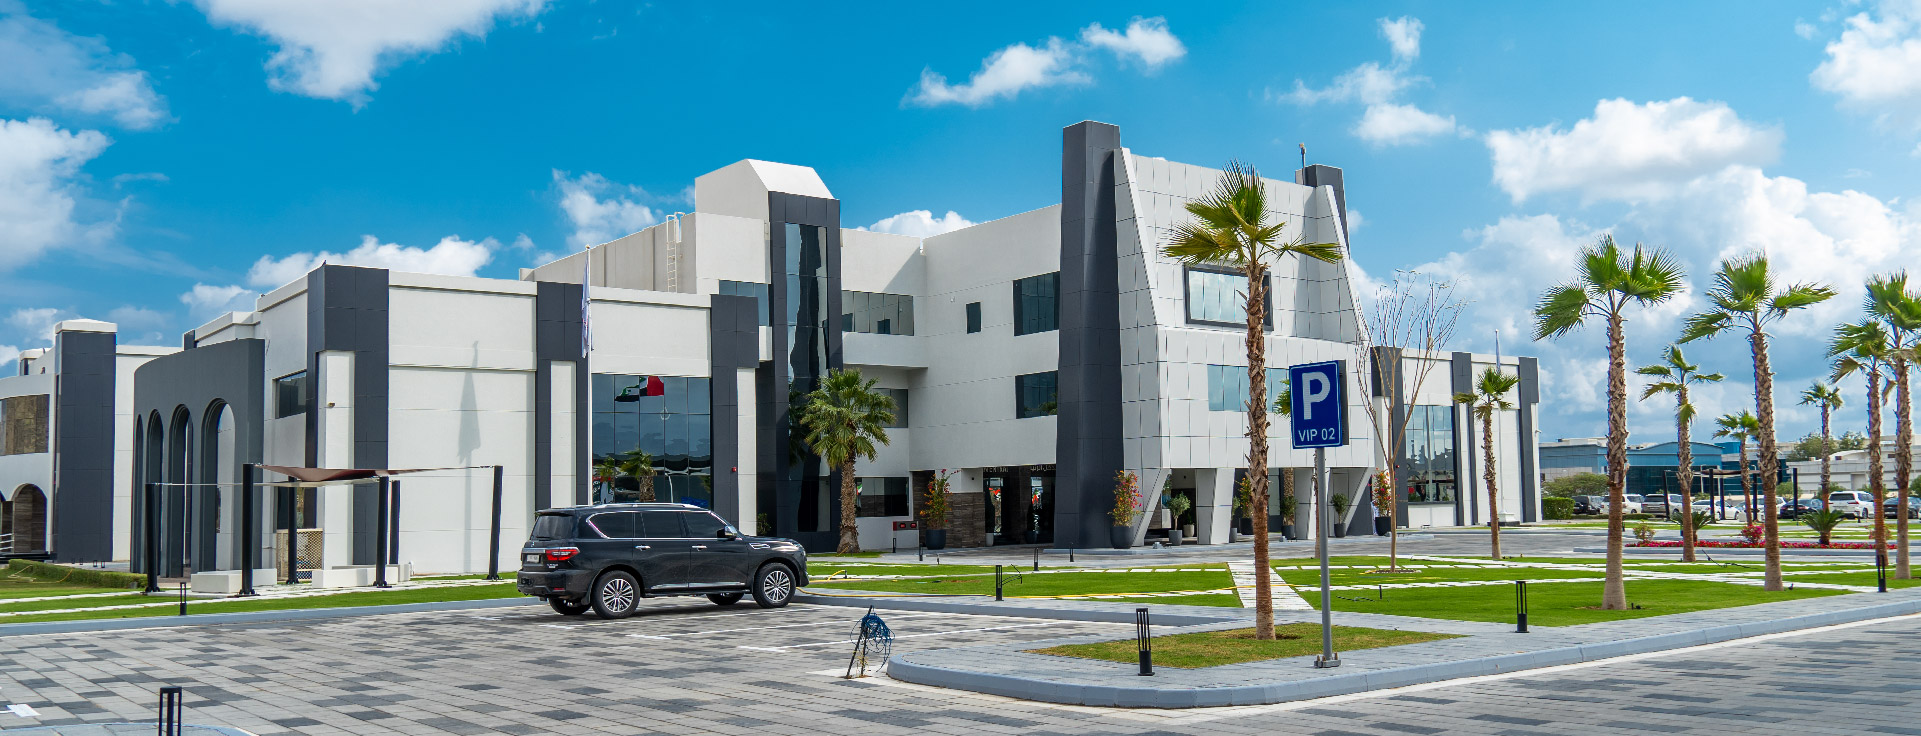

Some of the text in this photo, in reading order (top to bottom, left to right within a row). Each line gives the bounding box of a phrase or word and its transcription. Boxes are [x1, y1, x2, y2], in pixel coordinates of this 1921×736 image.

[1302, 371, 1330, 420] P
[1298, 428, 1335, 441] VIP 02
